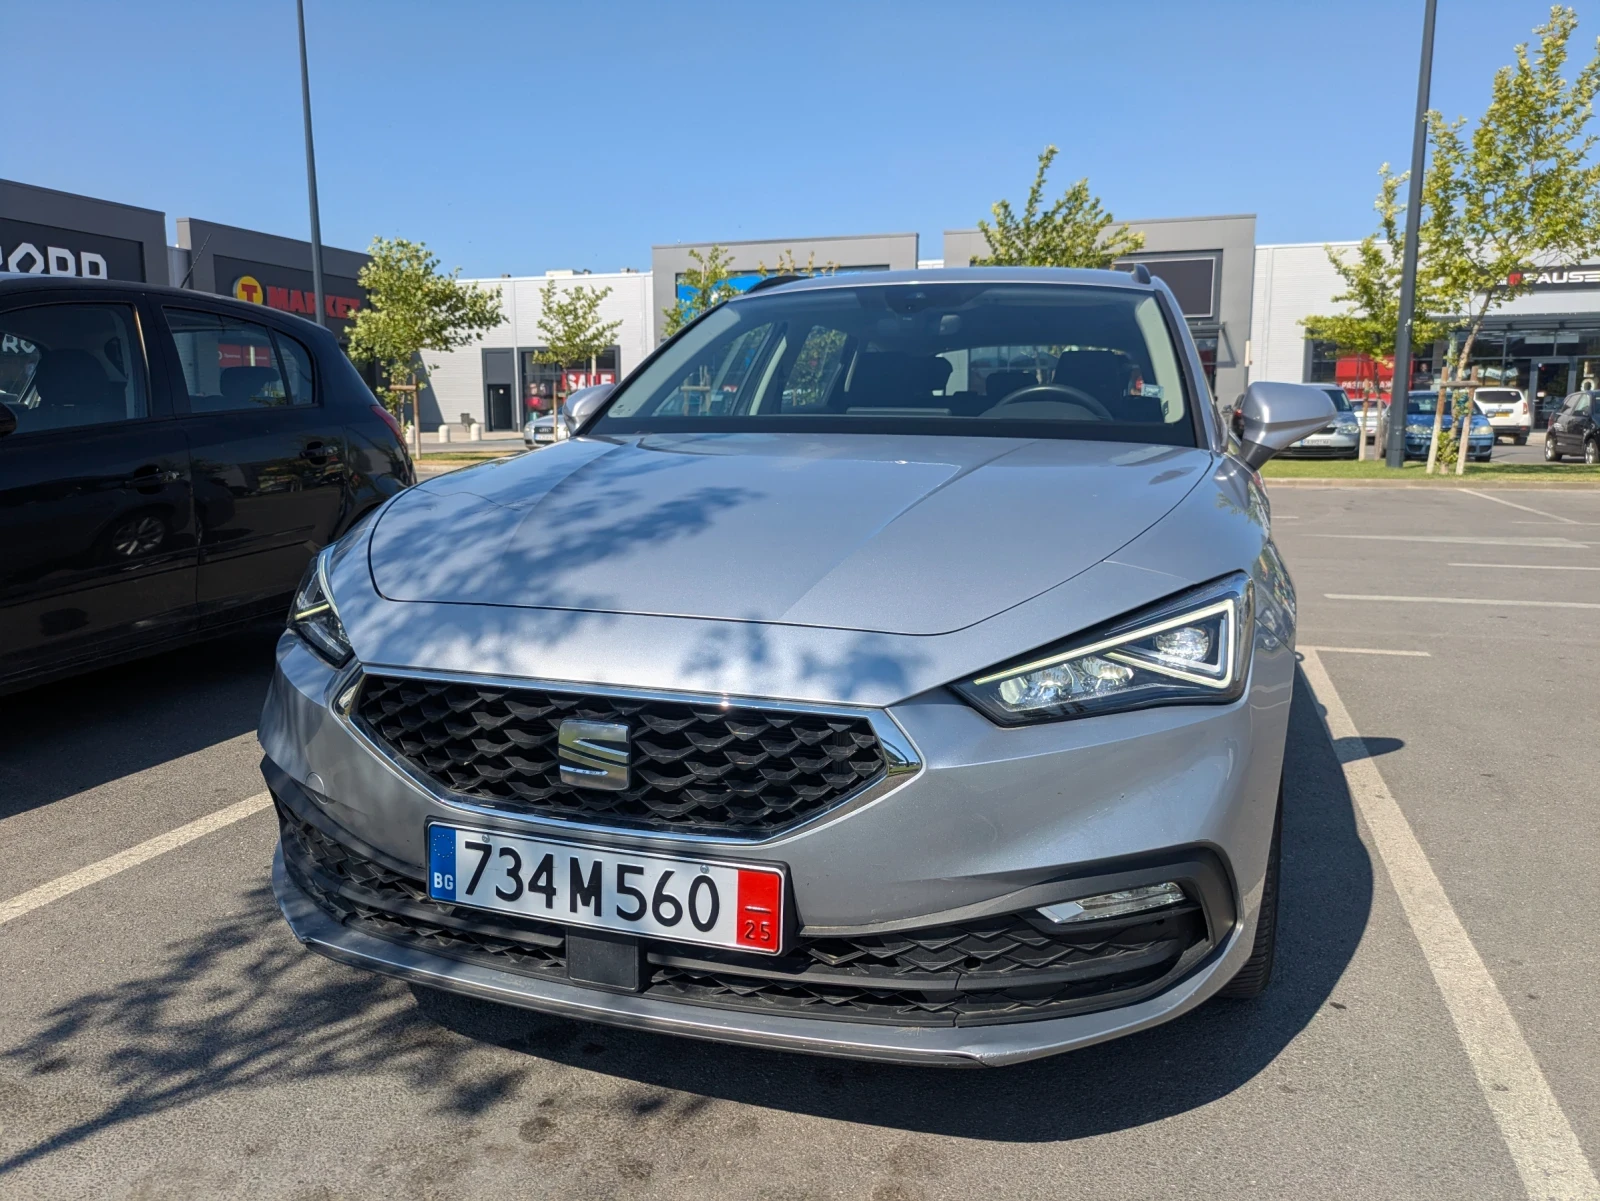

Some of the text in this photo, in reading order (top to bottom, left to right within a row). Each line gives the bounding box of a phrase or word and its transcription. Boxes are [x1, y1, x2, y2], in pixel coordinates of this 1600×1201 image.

[266, 286, 360, 319] MARKET
[433, 872, 454, 890] BG
[744, 920, 771, 941] 25
